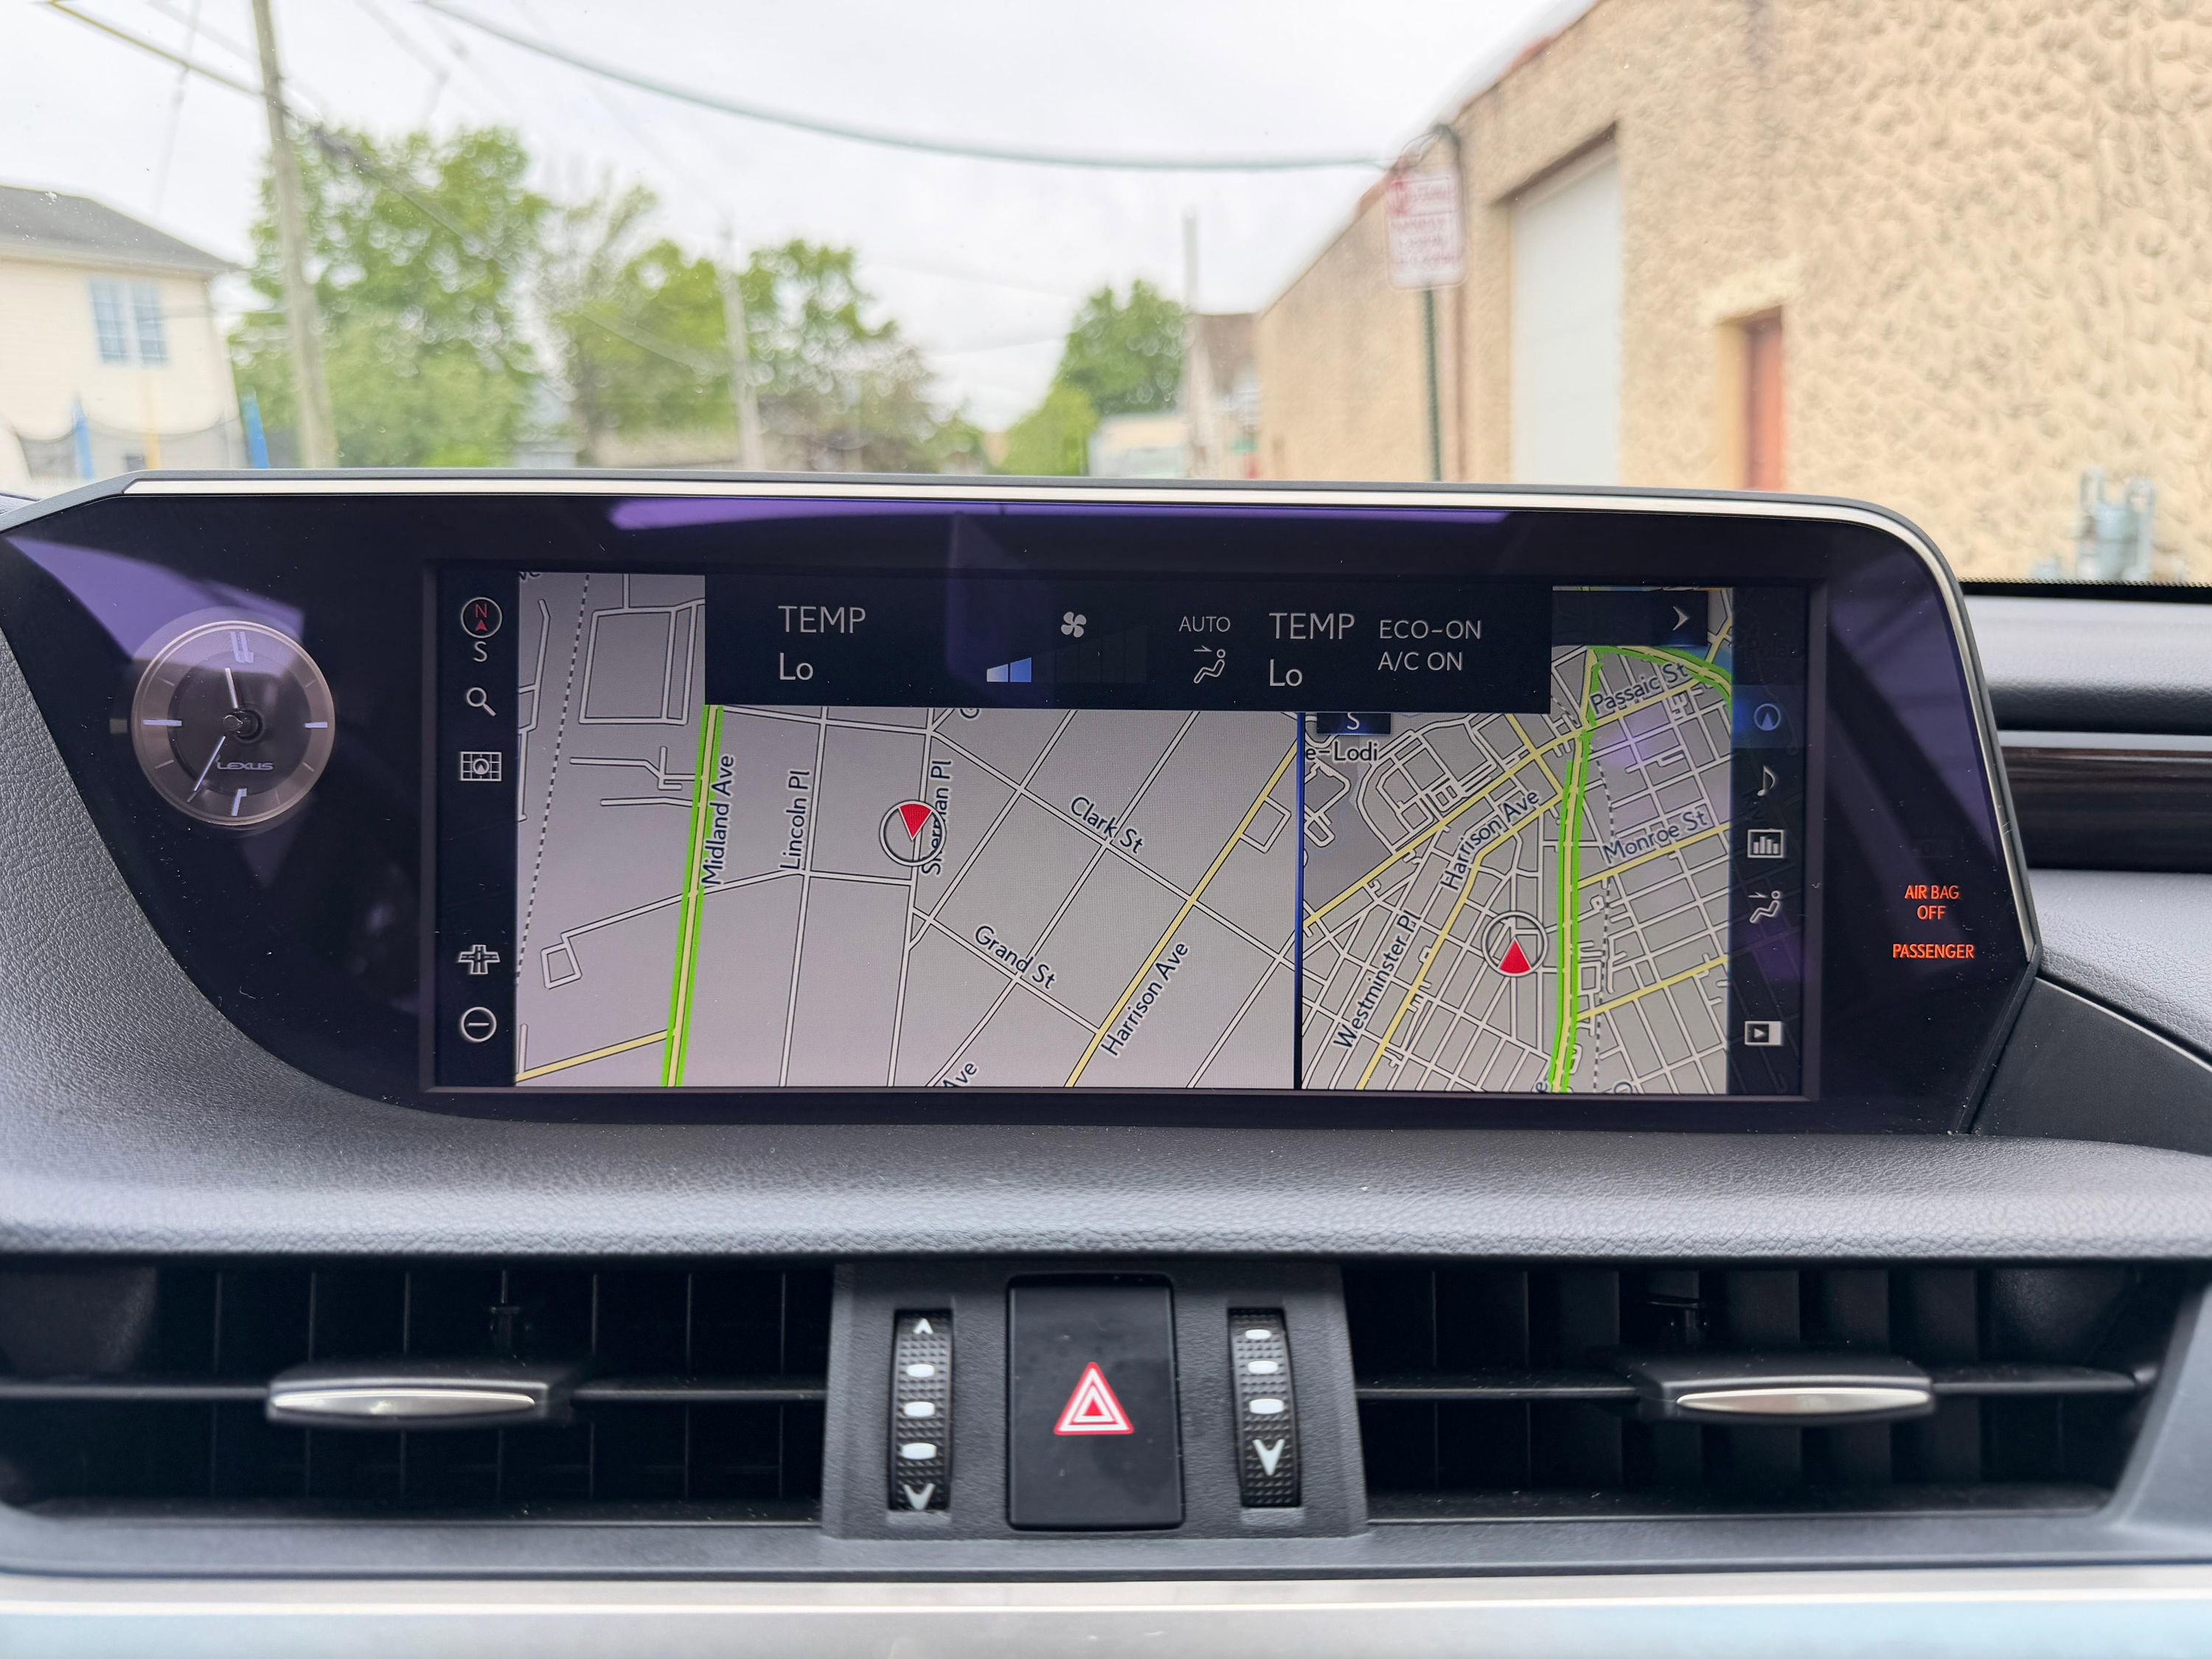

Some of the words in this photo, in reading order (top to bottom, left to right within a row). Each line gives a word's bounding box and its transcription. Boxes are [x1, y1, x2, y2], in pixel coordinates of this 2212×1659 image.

[476, 603, 487, 618] N
[778, 605, 866, 633] TEMP
[1178, 616, 1231, 633] AUTO
[1269, 613, 1355, 639] TEMP
[1380, 619, 1481, 639] ECO-ON
[473, 641, 487, 662] S
[1377, 651, 1419, 672] A/C
[1427, 651, 1463, 671] ON
[779, 653, 813, 681] Lo
[1270, 659, 1303, 686] Lo
[1590, 675, 1660, 715] Passaic
[1663, 663, 1688, 683] St
[217, 762, 274, 771] LEXUS
[711, 755, 734, 796] Ave
[931, 760, 952, 779] Pl
[788, 771, 810, 790] Pl
[779, 797, 807, 869] Lincoln
[1071, 796, 1117, 838] Clark
[1119, 828, 1143, 854] St
[1602, 824, 1680, 864] Monroe
[1682, 811, 1708, 831] St
[701, 802, 730, 885] Midland
[1439, 820, 1503, 891] Harrison
[1501, 791, 1540, 824] Ave
[1905, 885, 1927, 900] AIR
[1930, 885, 1960, 900] BAG
[1917, 905, 1947, 920] OFF
[975, 925, 1034, 973] Grand
[1032, 964, 1056, 990] St
[1893, 943, 1975, 959] PASSENGER
[1332, 935, 1408, 1048] Westminster
[1396, 909, 1422, 933] Pl
[1101, 981, 1164, 1057] Harrison
[1155, 943, 1189, 981] Ave
